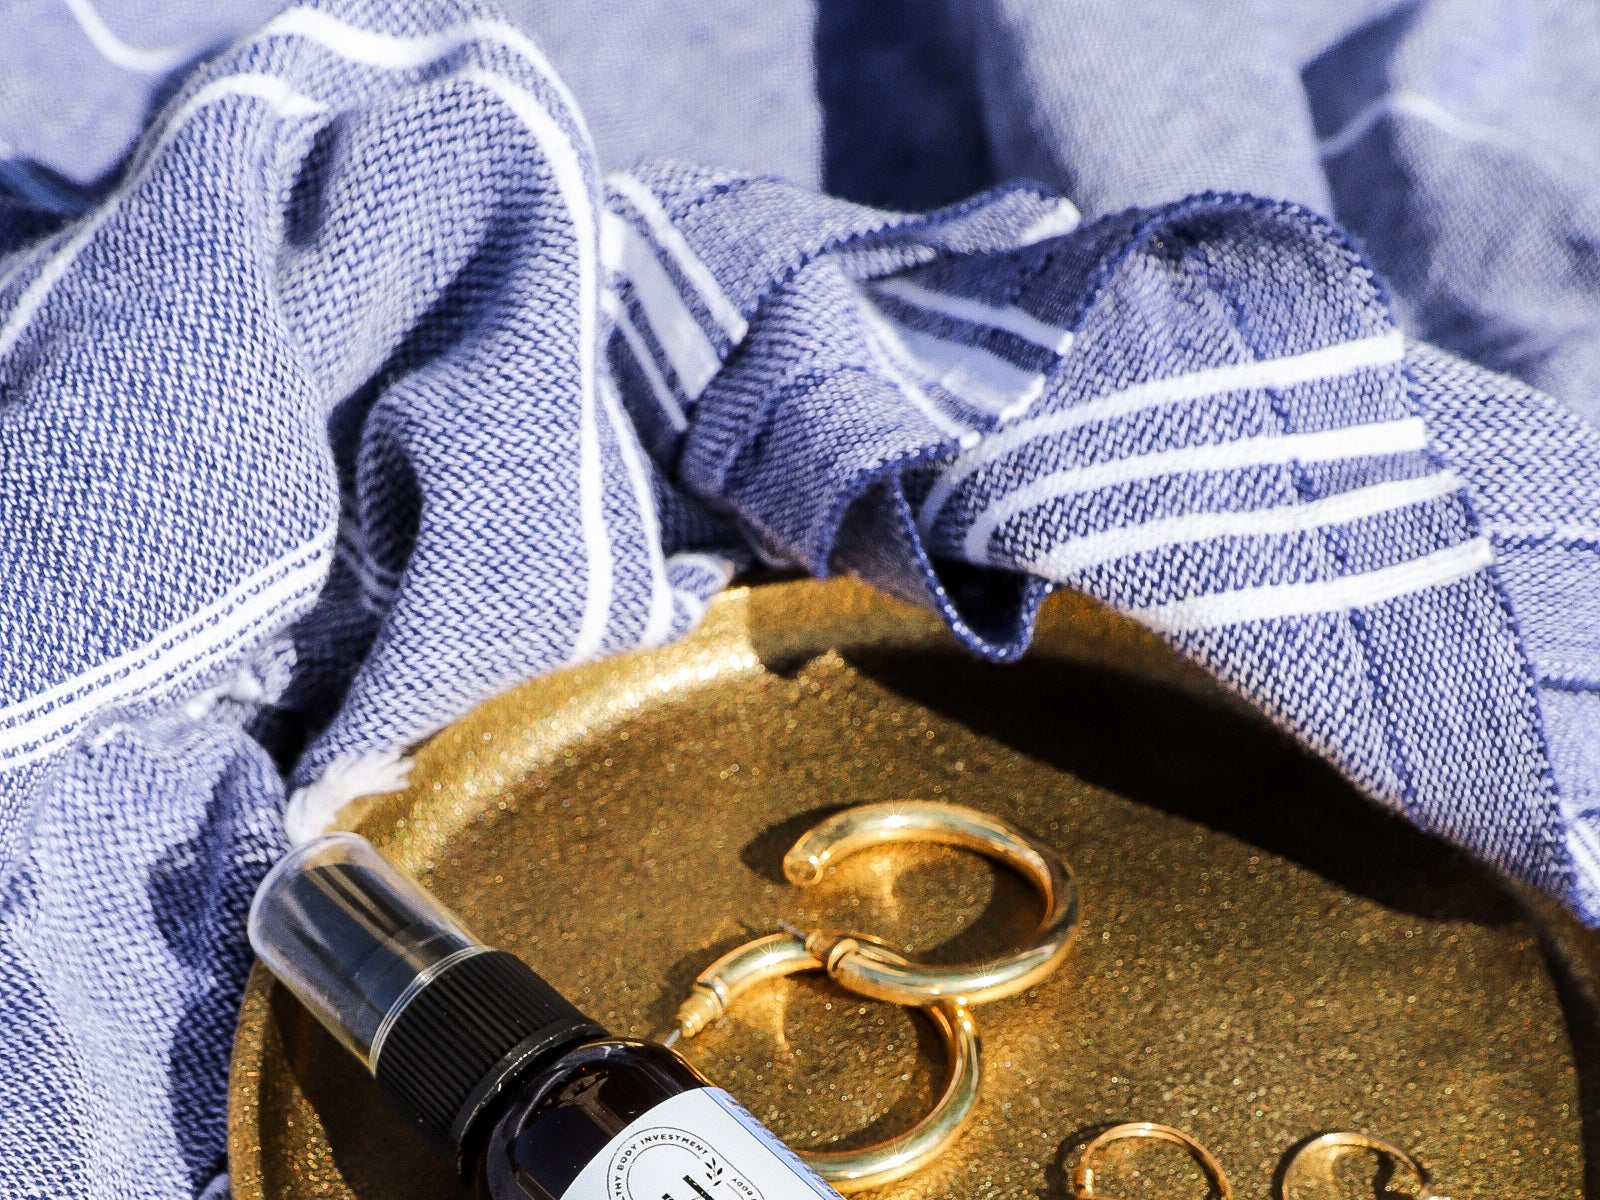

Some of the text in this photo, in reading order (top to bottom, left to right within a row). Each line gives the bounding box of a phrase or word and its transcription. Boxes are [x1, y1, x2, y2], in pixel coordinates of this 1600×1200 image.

[616, 1143, 637, 1171] BODY
[640, 1133, 709, 1155] INVESTMENT
[731, 1177, 753, 1196] BODY
